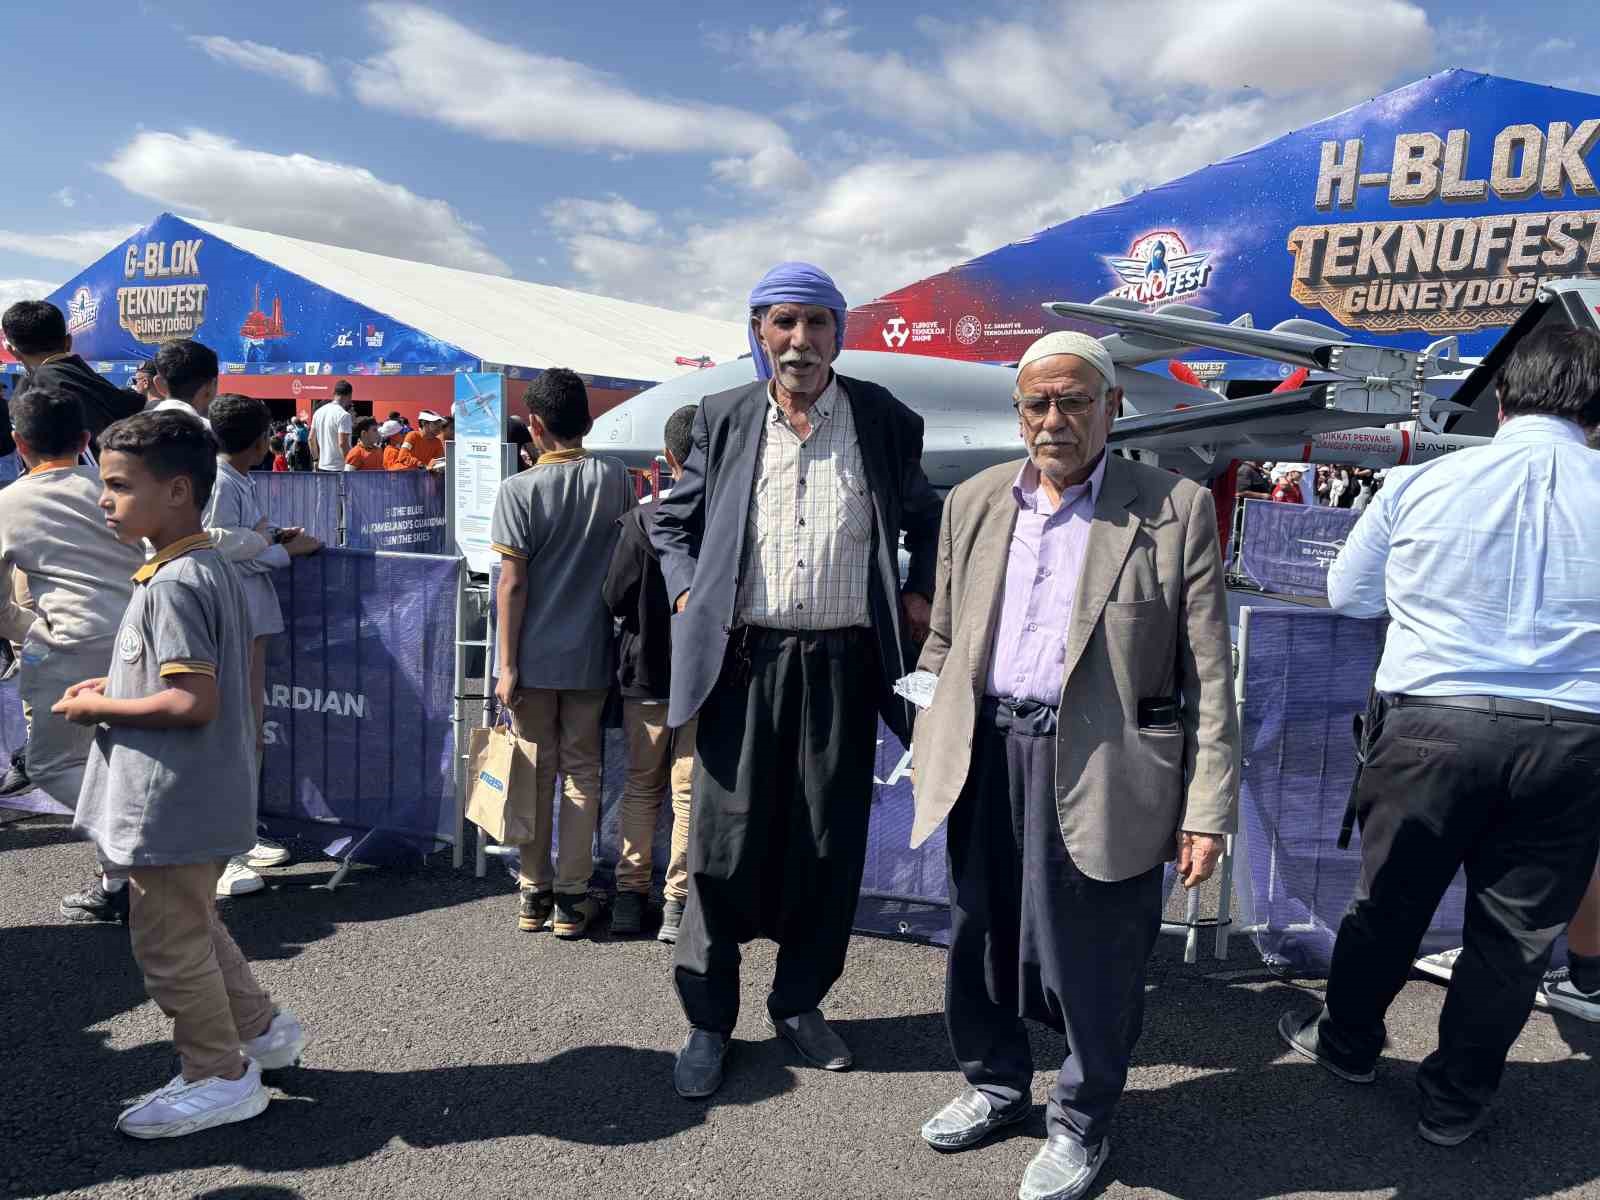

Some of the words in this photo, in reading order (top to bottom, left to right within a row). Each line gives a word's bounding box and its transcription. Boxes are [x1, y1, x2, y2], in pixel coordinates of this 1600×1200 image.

[1315, 119, 1600, 209] H-BLOK
[125, 240, 203, 278] G-BLOK
[118, 286, 206, 316] TEKNOFEST
[1344, 272, 1547, 314] GÜNEYDOĞ
[407, 505, 424, 515] BLUE
